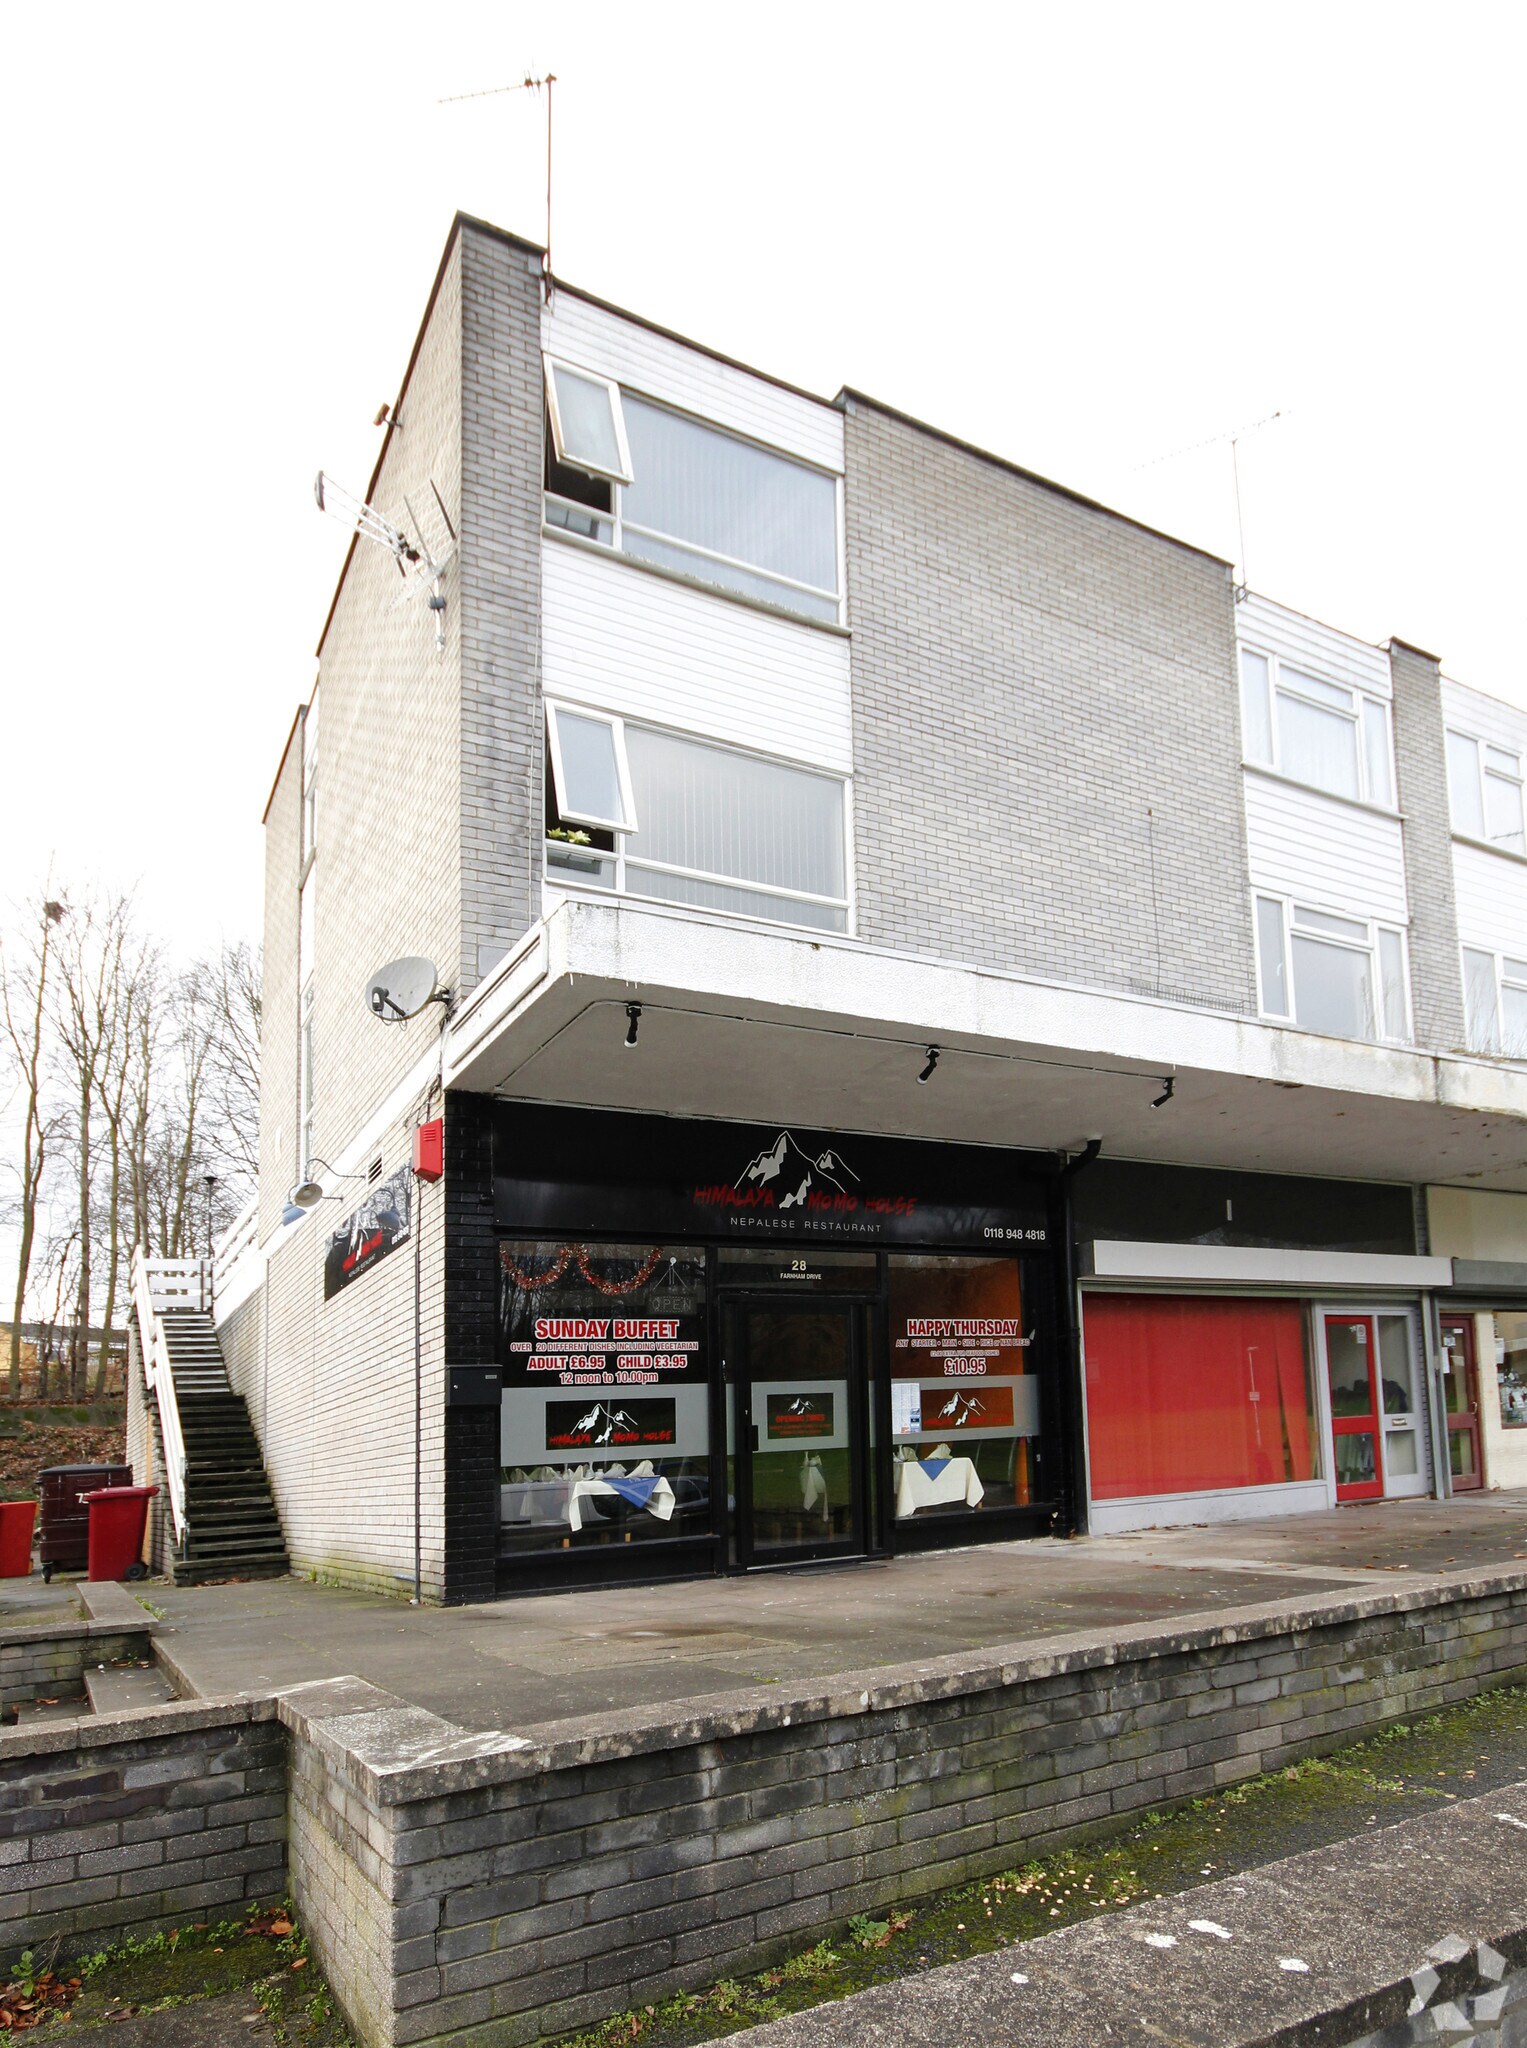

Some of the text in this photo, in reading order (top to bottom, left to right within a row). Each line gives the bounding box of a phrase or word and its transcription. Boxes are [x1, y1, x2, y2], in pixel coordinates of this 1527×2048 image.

[693, 1184, 776, 1208] HIMALAYA
[864, 1196, 919, 1217] HOUSE
[730, 1217, 882, 1233] NEPALESE RESTAURANT
[984, 1227, 1046, 1240] 0118 948 4818
[791, 1260, 807, 1271] 28
[652, 1298, 691, 1311] OPEN
[535, 1319, 679, 1339] SUNDAY BUFFET
[907, 1319, 1018, 1336] HAPPY THURSDAY
[510, 1341, 699, 1352] OVER 20 DIFFERENT DISHES INCLUDING VEGETARIAN
[941, 1339, 957, 1347] MAIN
[962, 1338, 976, 1347] SIDE
[527, 1354, 688, 1370] ADULT £6.95 CHILD £3.95
[944, 1358, 986, 1375] £10.95
[559, 1371, 659, 1385] 12 noon to 10.00pm
